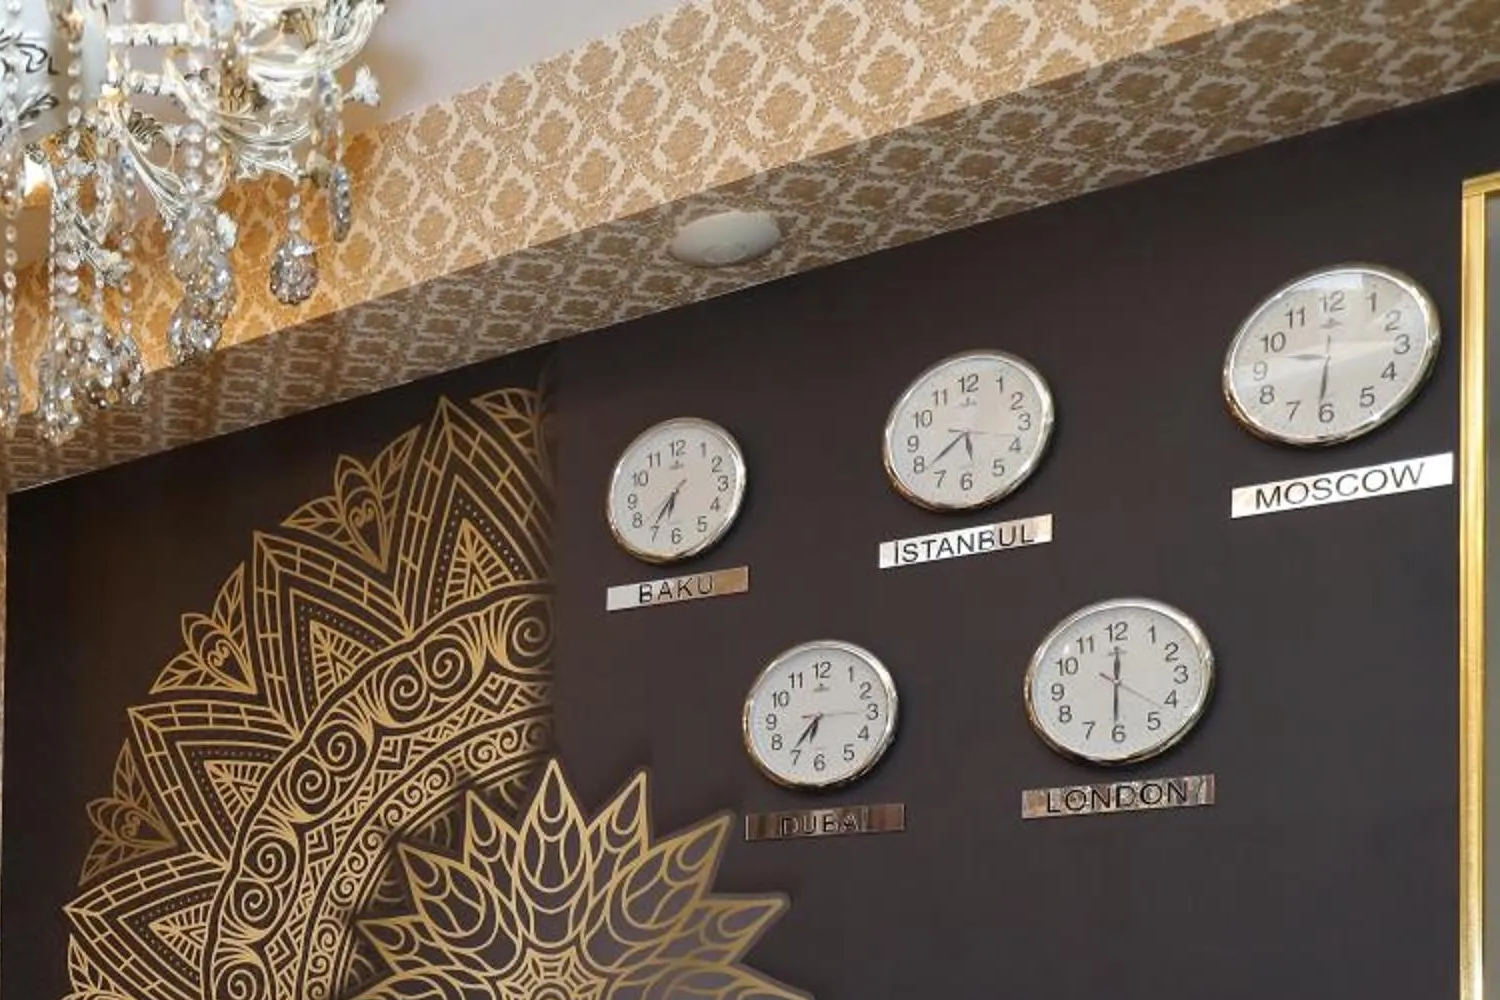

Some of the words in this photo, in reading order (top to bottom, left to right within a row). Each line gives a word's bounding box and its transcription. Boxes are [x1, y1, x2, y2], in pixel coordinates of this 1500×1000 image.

[1321, 291, 1344, 312] 12
[1366, 292, 1376, 312] 1
[1285, 307, 1305, 328] 11
[1385, 310, 1400, 331] 2
[1261, 332, 1286, 352] 10
[1394, 334, 1410, 354] 3
[1253, 361, 1267, 381] 9
[1381, 362, 1396, 380] 4
[958, 374, 978, 392] 12
[997, 377, 1003, 392] 1
[933, 389, 947, 405] 11
[1011, 392, 1023, 410] 2
[1260, 385, 1274, 404] 8
[1360, 386, 1374, 407] 5
[913, 410, 932, 427] 10
[1287, 401, 1300, 420] 7
[1319, 403, 1334, 422] 6
[1019, 413, 1030, 430] 3
[670, 440, 686, 456] 12
[701, 442, 706, 458] 1
[907, 435, 918, 452] 9
[1009, 437, 1021, 453] 4
[647, 452, 660, 467] 11
[712, 456, 722, 472] 2
[914, 456, 924, 473] 8
[993, 459, 1004, 476] 5
[633, 471, 648, 486] 10
[718, 476, 728, 491] 3
[934, 470, 946, 487] 7
[961, 473, 972, 490] 6
[1254, 462, 1425, 510] MOSCOW
[628, 493, 637, 509] 9
[710, 497, 720, 511] 4
[632, 512, 642, 528] 8
[697, 516, 707, 532] 5
[651, 525, 660, 542] 7
[671, 528, 681, 544] 6
[639, 575, 713, 603] BAKU
[1104, 622, 1128, 641] 12
[1149, 625, 1155, 643] 1
[1077, 636, 1094, 654] 11
[1165, 642, 1179, 661] 2
[813, 662, 831, 678] 12
[848, 666, 853, 682] 1
[1056, 657, 1078, 675] 10
[1174, 665, 1188, 684] 3
[789, 672, 802, 688] 11
[860, 682, 871, 699] 2
[1052, 683, 1064, 700] 9
[1164, 690, 1177, 707] 4
[772, 691, 789, 708] 10
[868, 704, 878, 720] 3
[1059, 705, 1072, 722] 8
[766, 714, 776, 730] 9
[1148, 712, 1160, 730] 5
[858, 726, 868, 740] 4
[1082, 721, 1095, 740] 7
[1112, 725, 1125, 742] 6
[772, 734, 782, 750] 8
[791, 750, 801, 765] 7
[844, 744, 854, 760] 5
[814, 754, 825, 771] 6
[1046, 782, 1187, 813] LONDON
